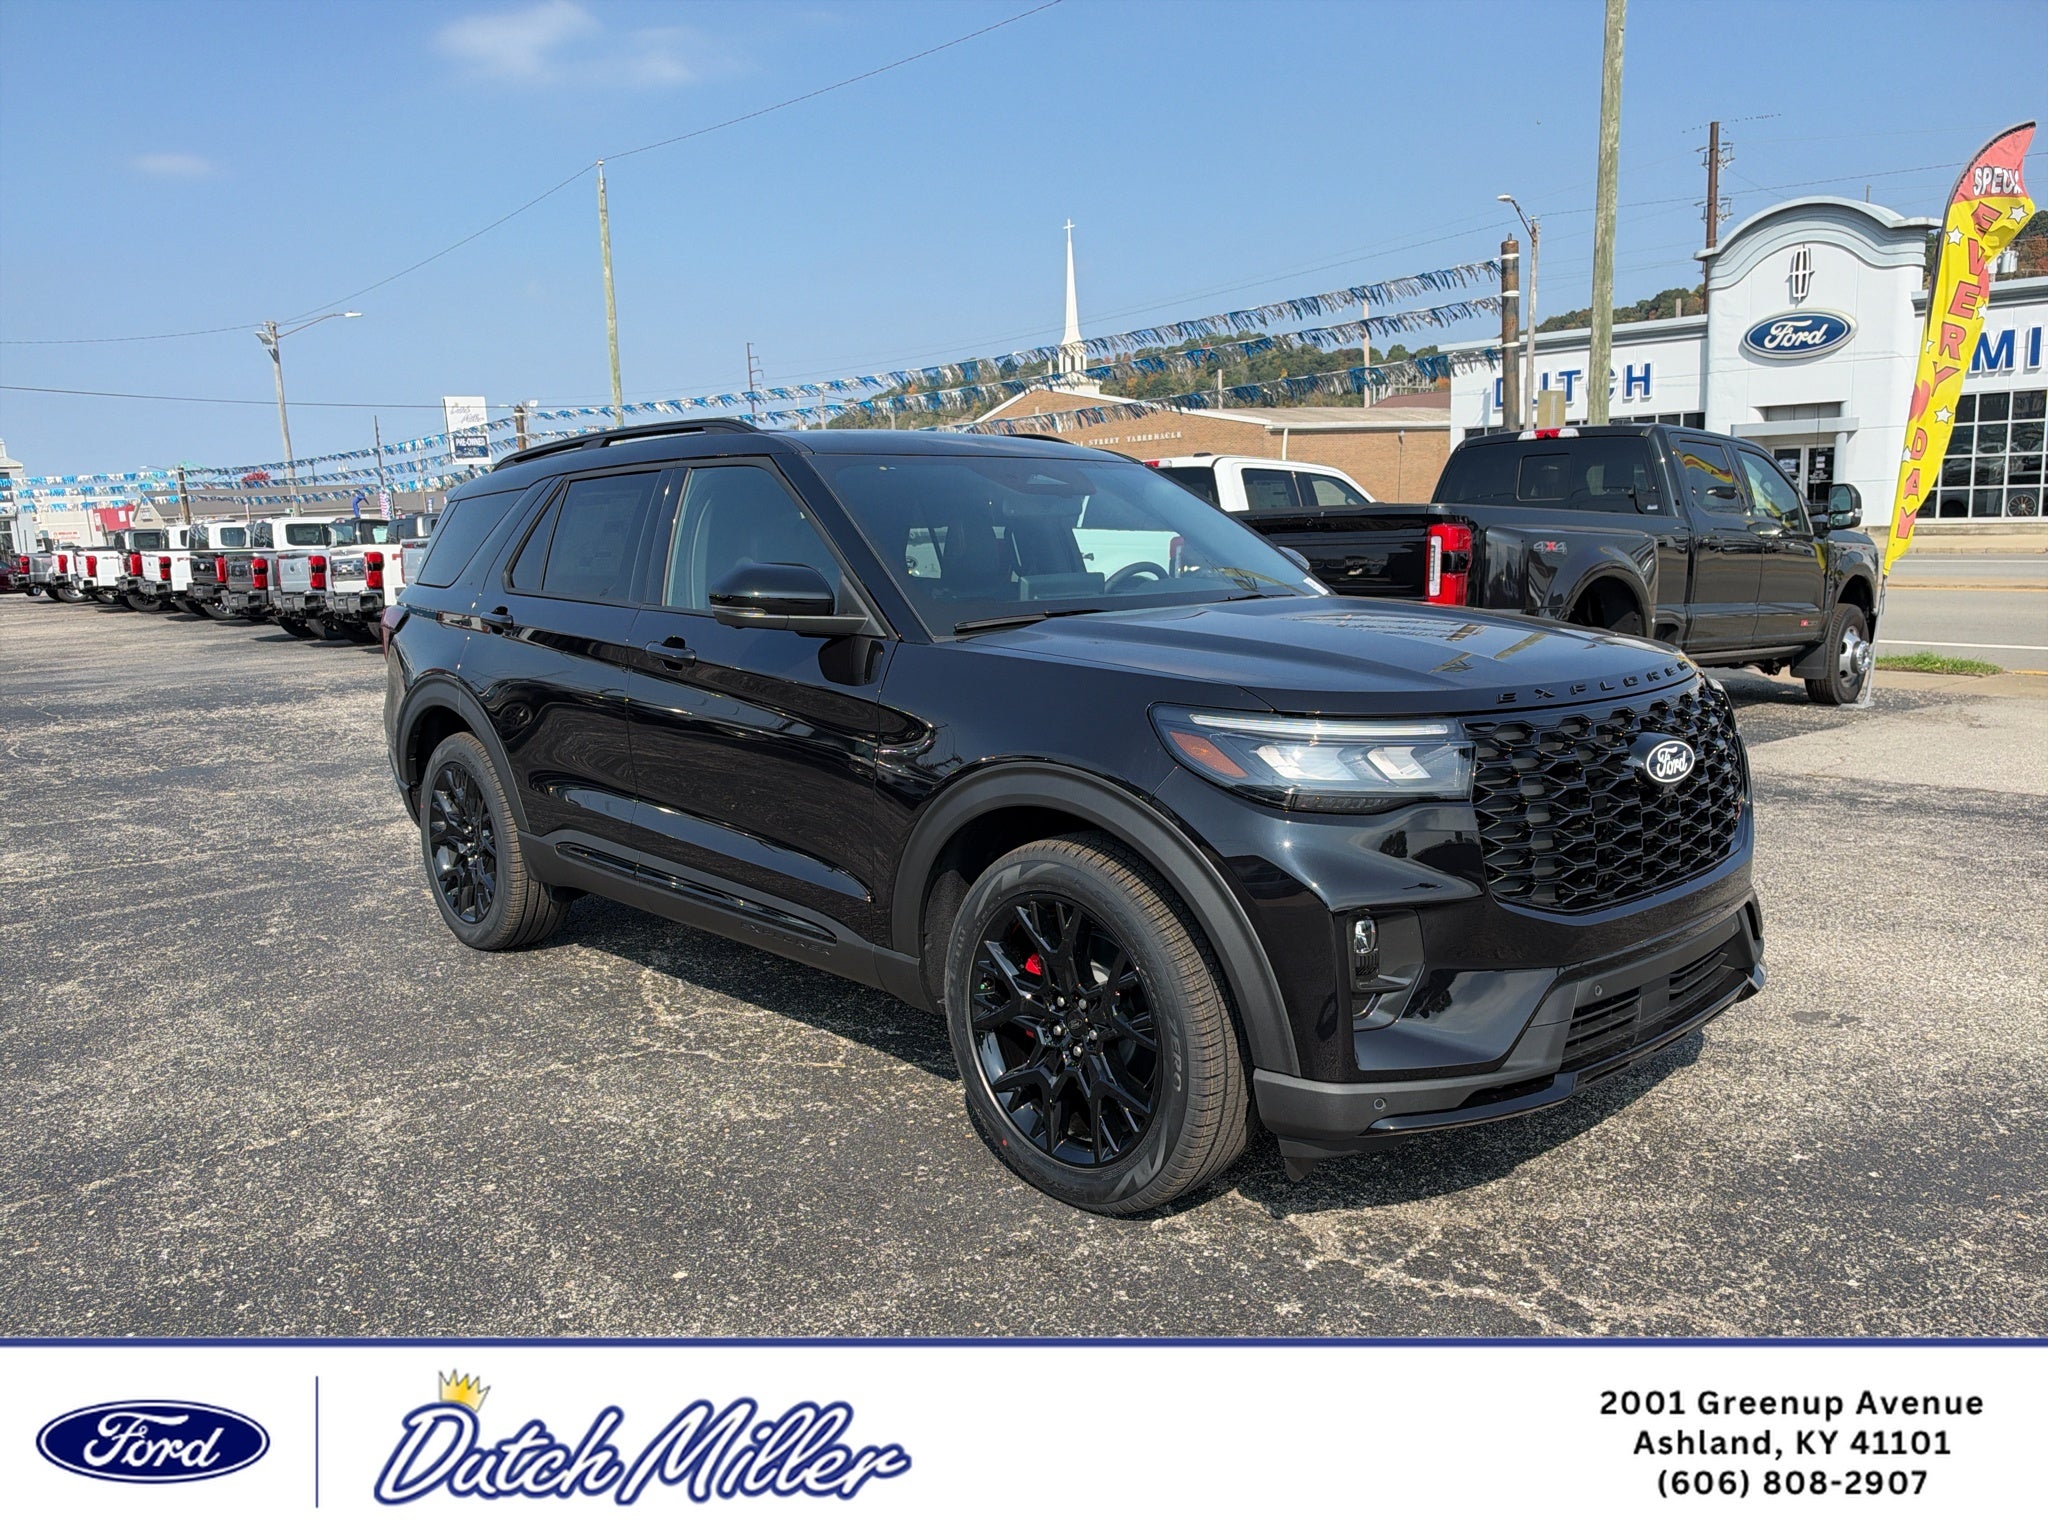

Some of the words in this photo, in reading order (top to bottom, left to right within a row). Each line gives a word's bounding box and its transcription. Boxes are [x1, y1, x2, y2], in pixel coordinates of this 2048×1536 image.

[1764, 319, 1829, 349] Ford
[1088, 437, 1120, 446] STREET
[1126, 431, 1183, 443] TABERNACLE
[1896, 427, 1928, 539] DAY
[1496, 660, 1690, 704] EXPLORER
[1656, 746, 1689, 778] Ford
[1165, 1016, 1183, 1093] ZERO
